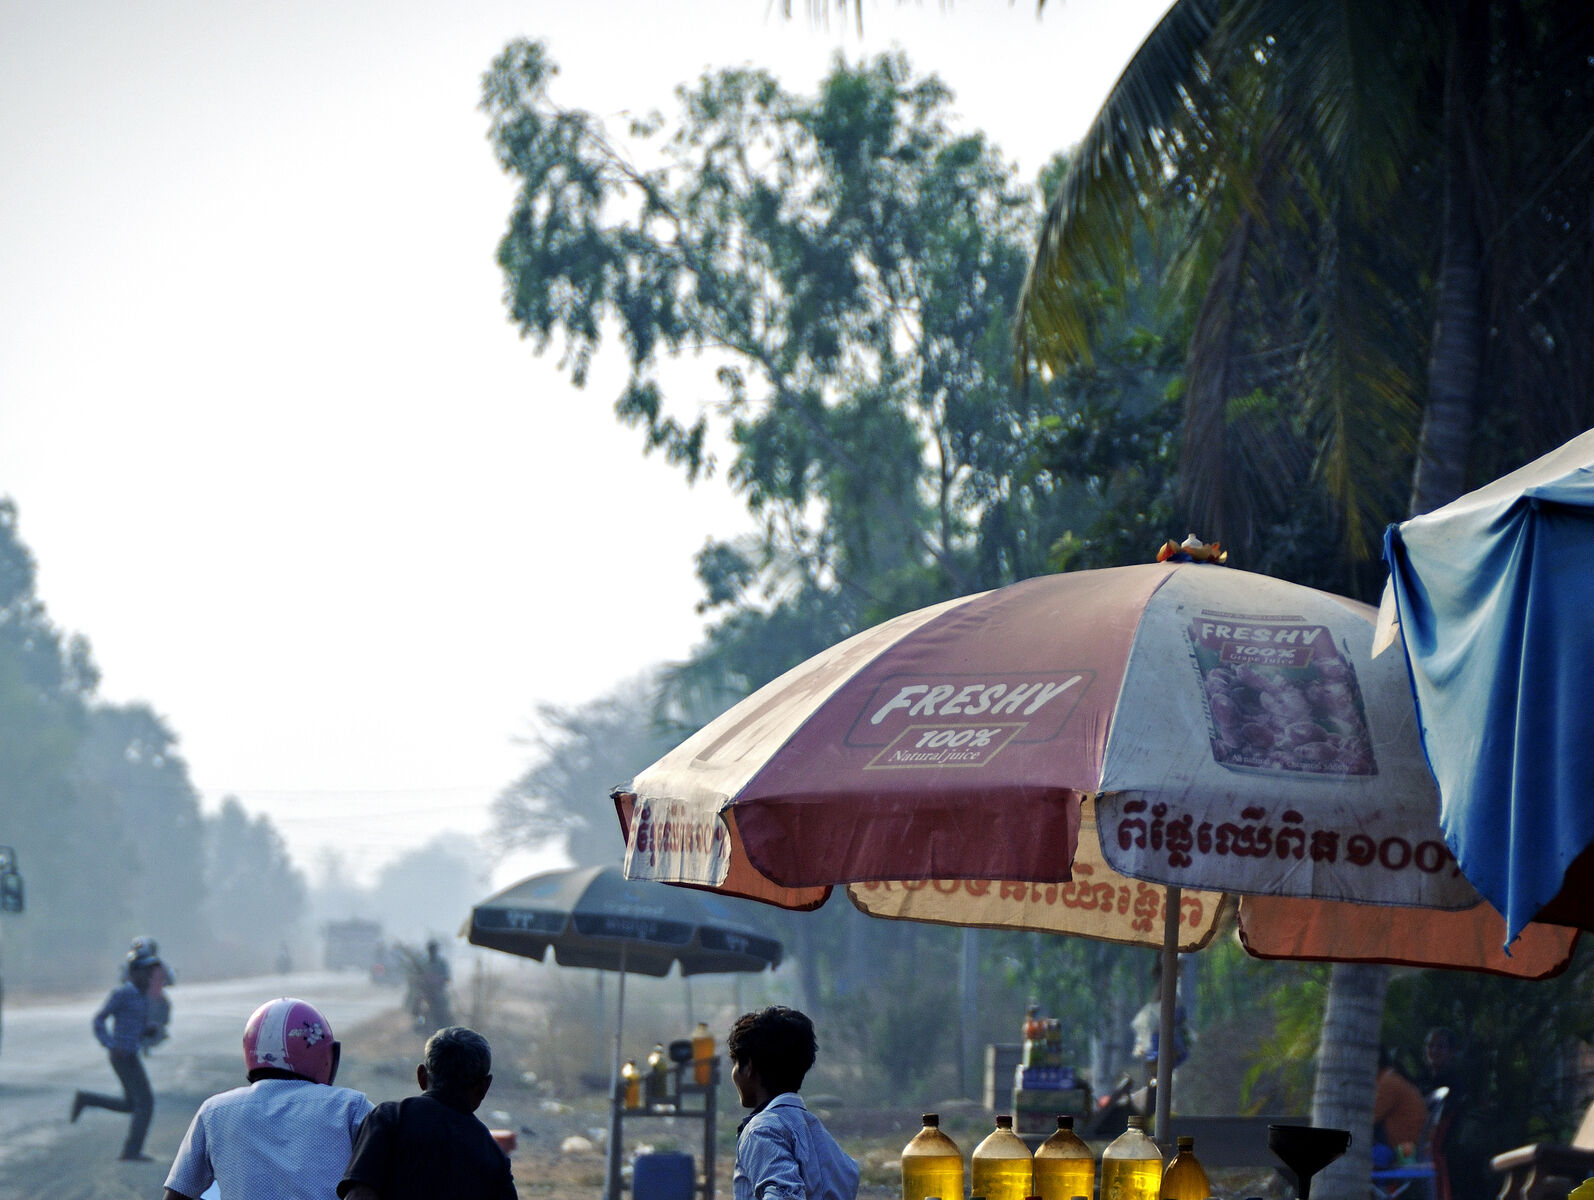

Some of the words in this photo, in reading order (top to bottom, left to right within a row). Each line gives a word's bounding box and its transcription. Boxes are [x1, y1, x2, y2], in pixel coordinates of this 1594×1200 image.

[1201, 622, 1322, 645] FRESHY
[1229, 653, 1260, 664] Grape
[1235, 645, 1297, 658] 100%
[870, 675, 1082, 724] FRESHY
[915, 728, 1001, 748] 100%
[888, 749, 943, 763] Natural
[938, 750, 981, 763] juice
